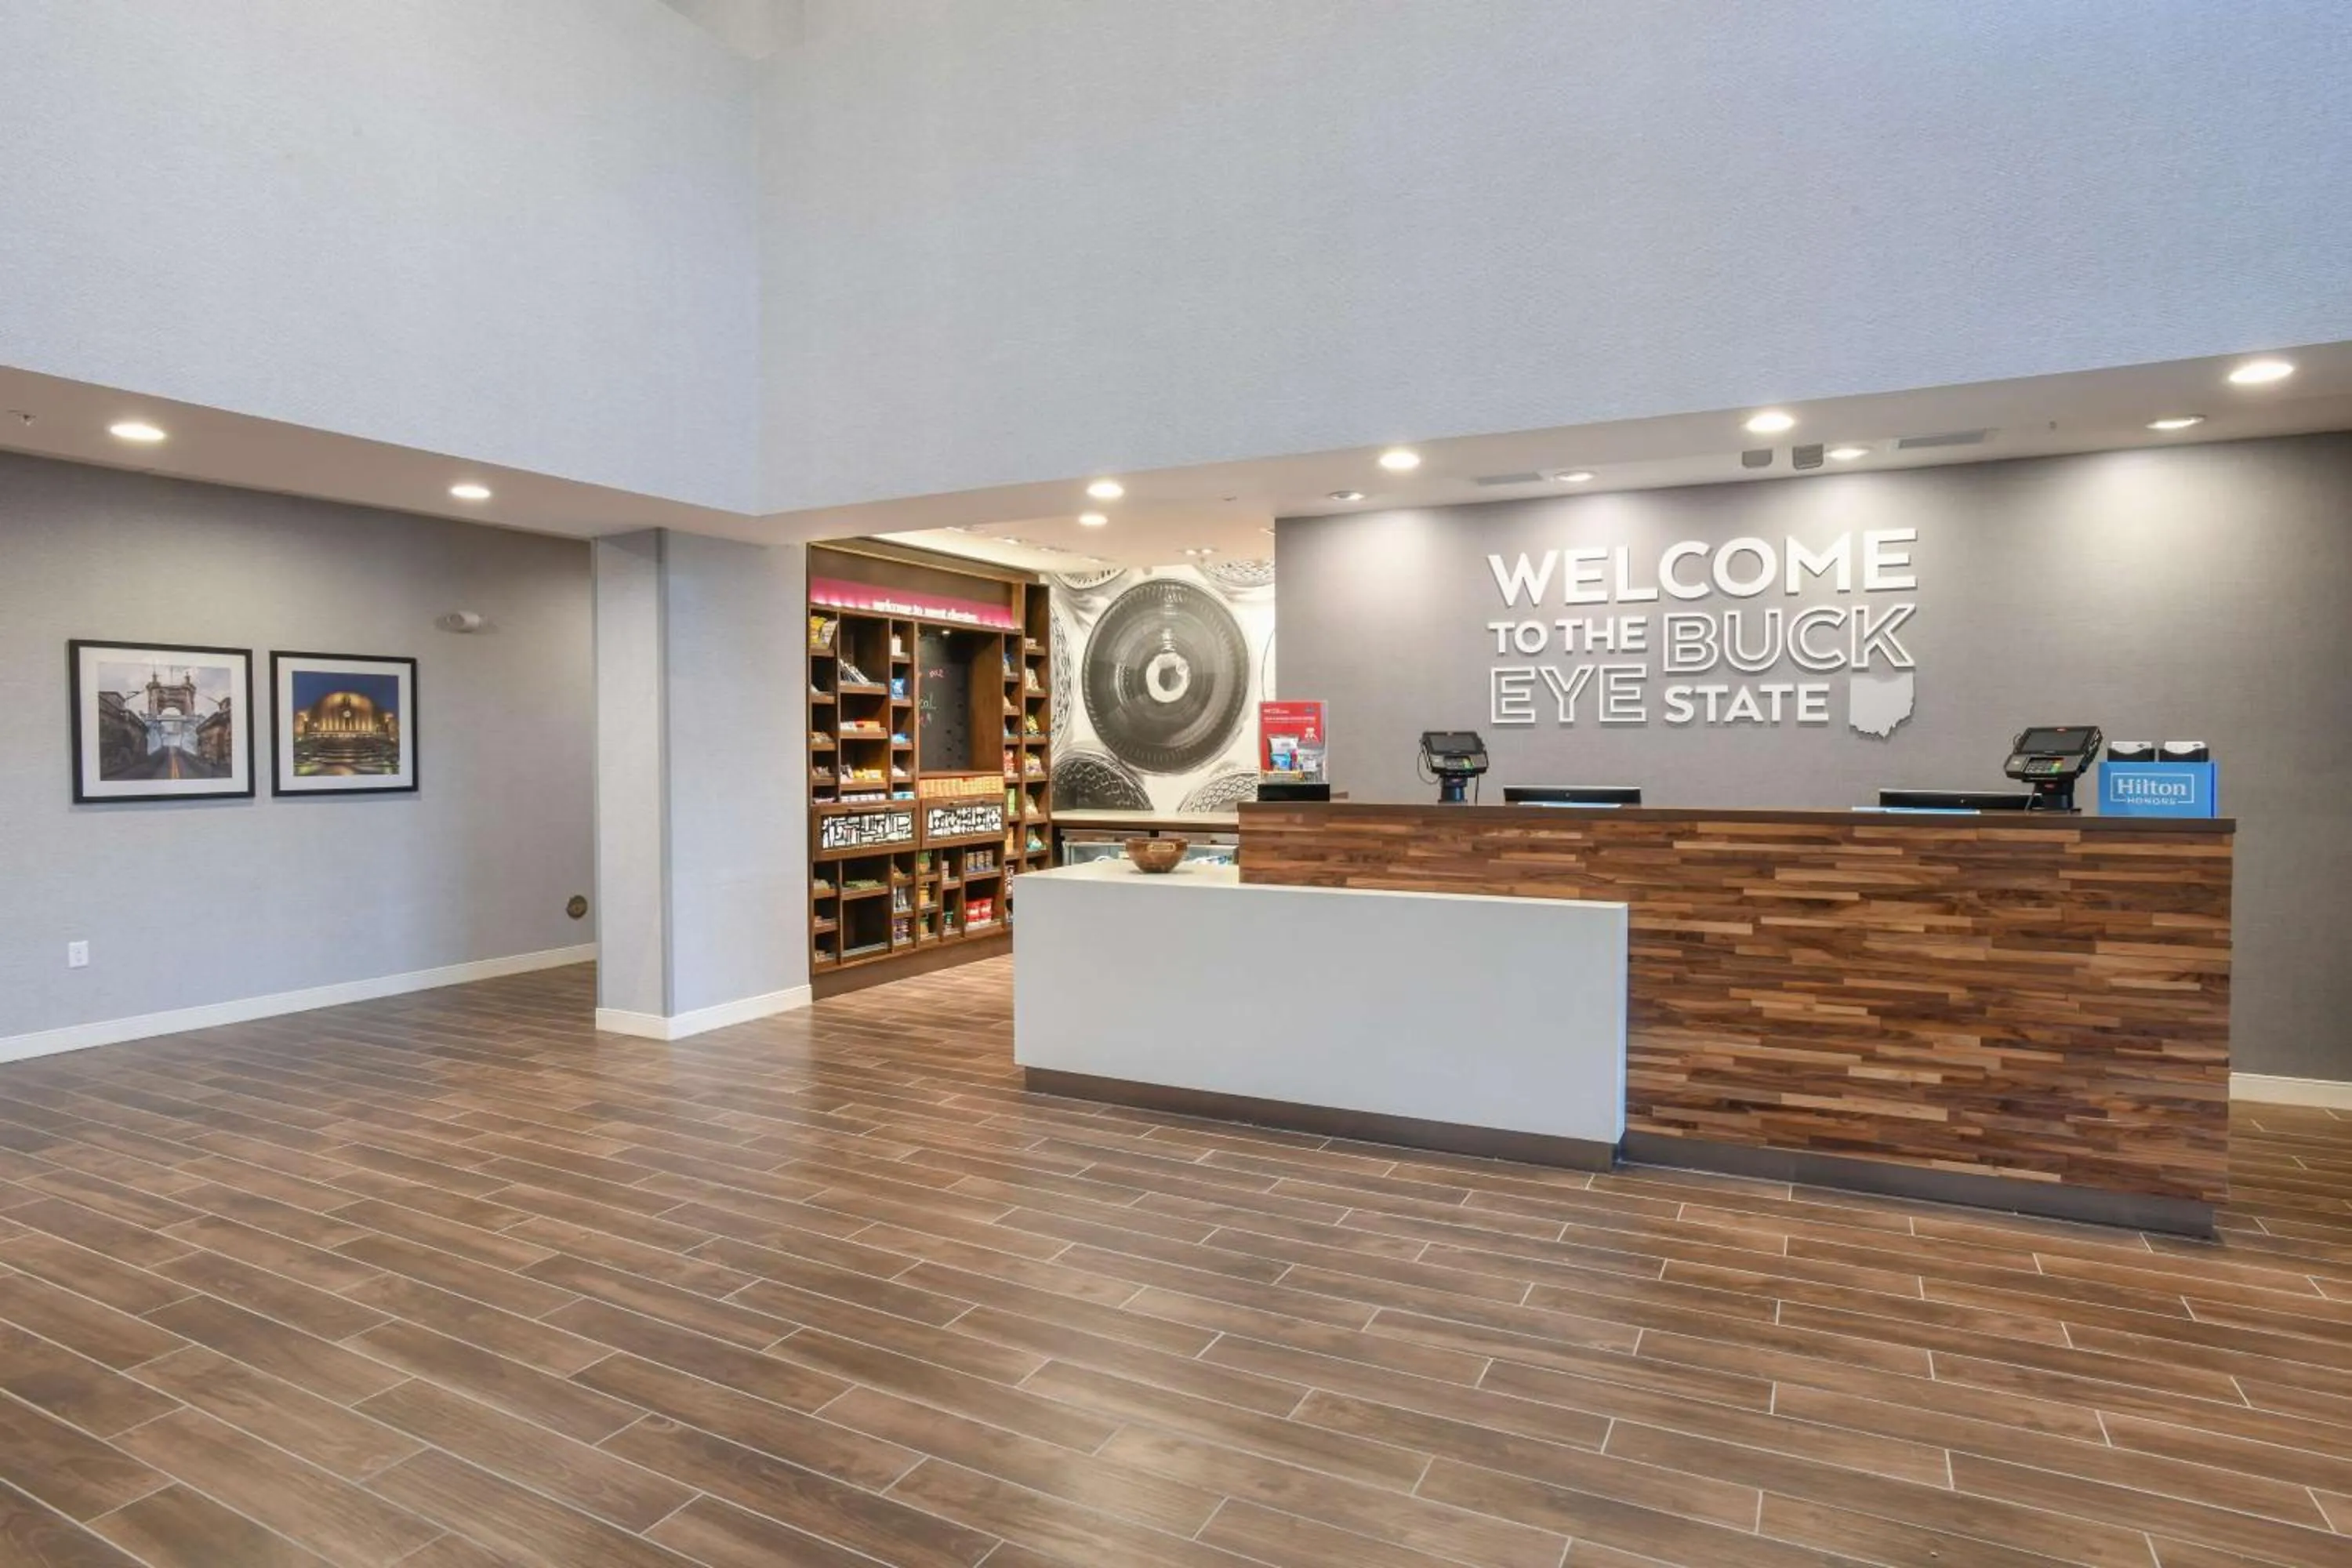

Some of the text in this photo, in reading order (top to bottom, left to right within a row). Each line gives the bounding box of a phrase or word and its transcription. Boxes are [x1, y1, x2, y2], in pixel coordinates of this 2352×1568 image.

[1488, 528, 1918, 606] WELCOME
[1488, 603, 1916, 673] TO THE BUCK
[1490, 664, 1830, 724] EYE STATE
[2118, 779, 2187, 796] Hilton
[2127, 797, 2177, 805] HONORS
